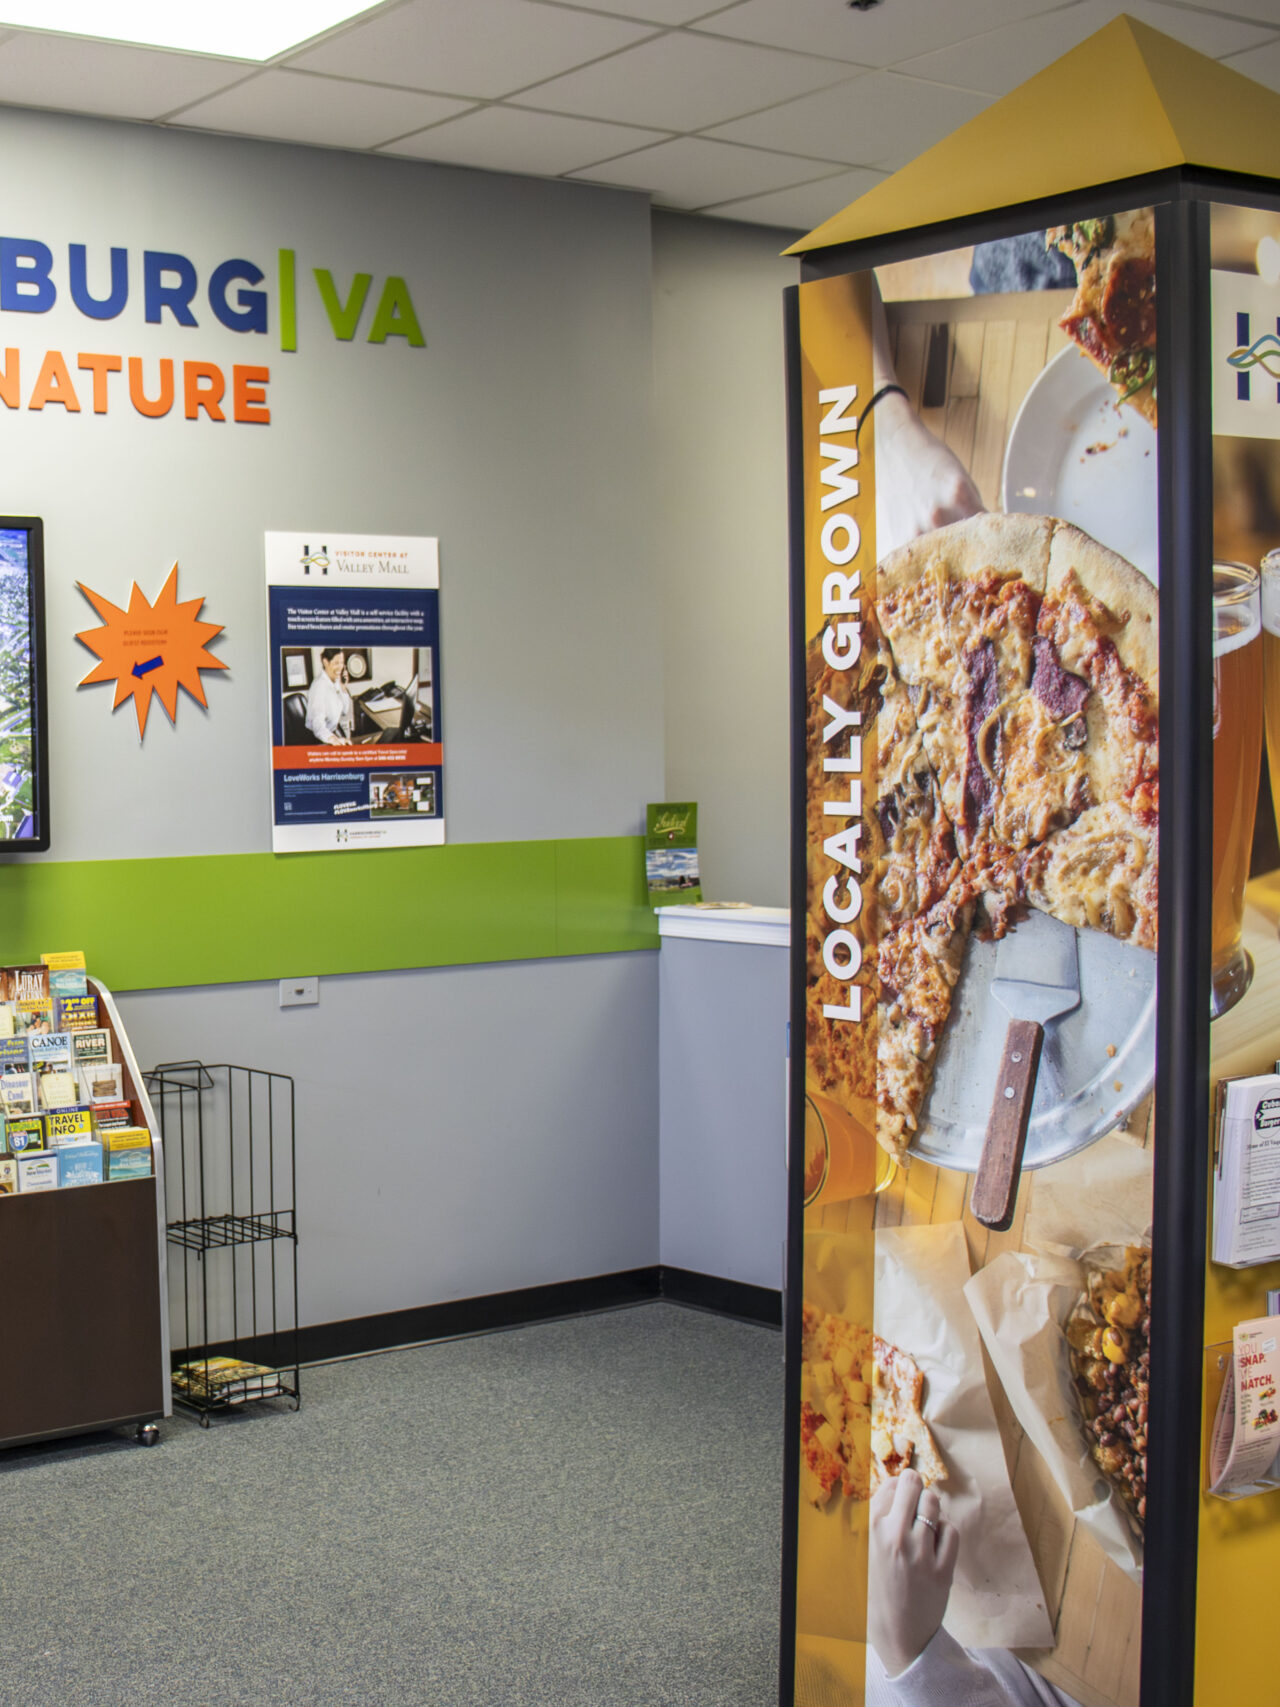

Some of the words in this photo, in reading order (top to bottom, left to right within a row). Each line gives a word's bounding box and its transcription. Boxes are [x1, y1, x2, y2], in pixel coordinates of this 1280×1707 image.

[312, 267, 427, 348] VA
[818, 384, 862, 671] GROWN
[336, 559, 375, 573] VALLEY
[378, 560, 409, 574] MALL
[284, 774, 320, 782] LoveWorks
[321, 772, 365, 782] Harrisonburg
[822, 694, 863, 1023] LOCALLY
[14, 970, 44, 990] LURAY
[32, 1036, 68, 1048] CANOE
[76, 1038, 106, 1050] RIVER
[0, 1080, 29, 1090] Dinosaur
[8, 1092, 24, 1100] Land
[1261, 1100, 1280, 1110] Cuba
[48, 1114, 84, 1126] TRAVEL
[50, 1124, 76, 1136] INFO
[14, 1137, 26, 1148] 81
[1240, 1352, 1266, 1368] SNAP.
